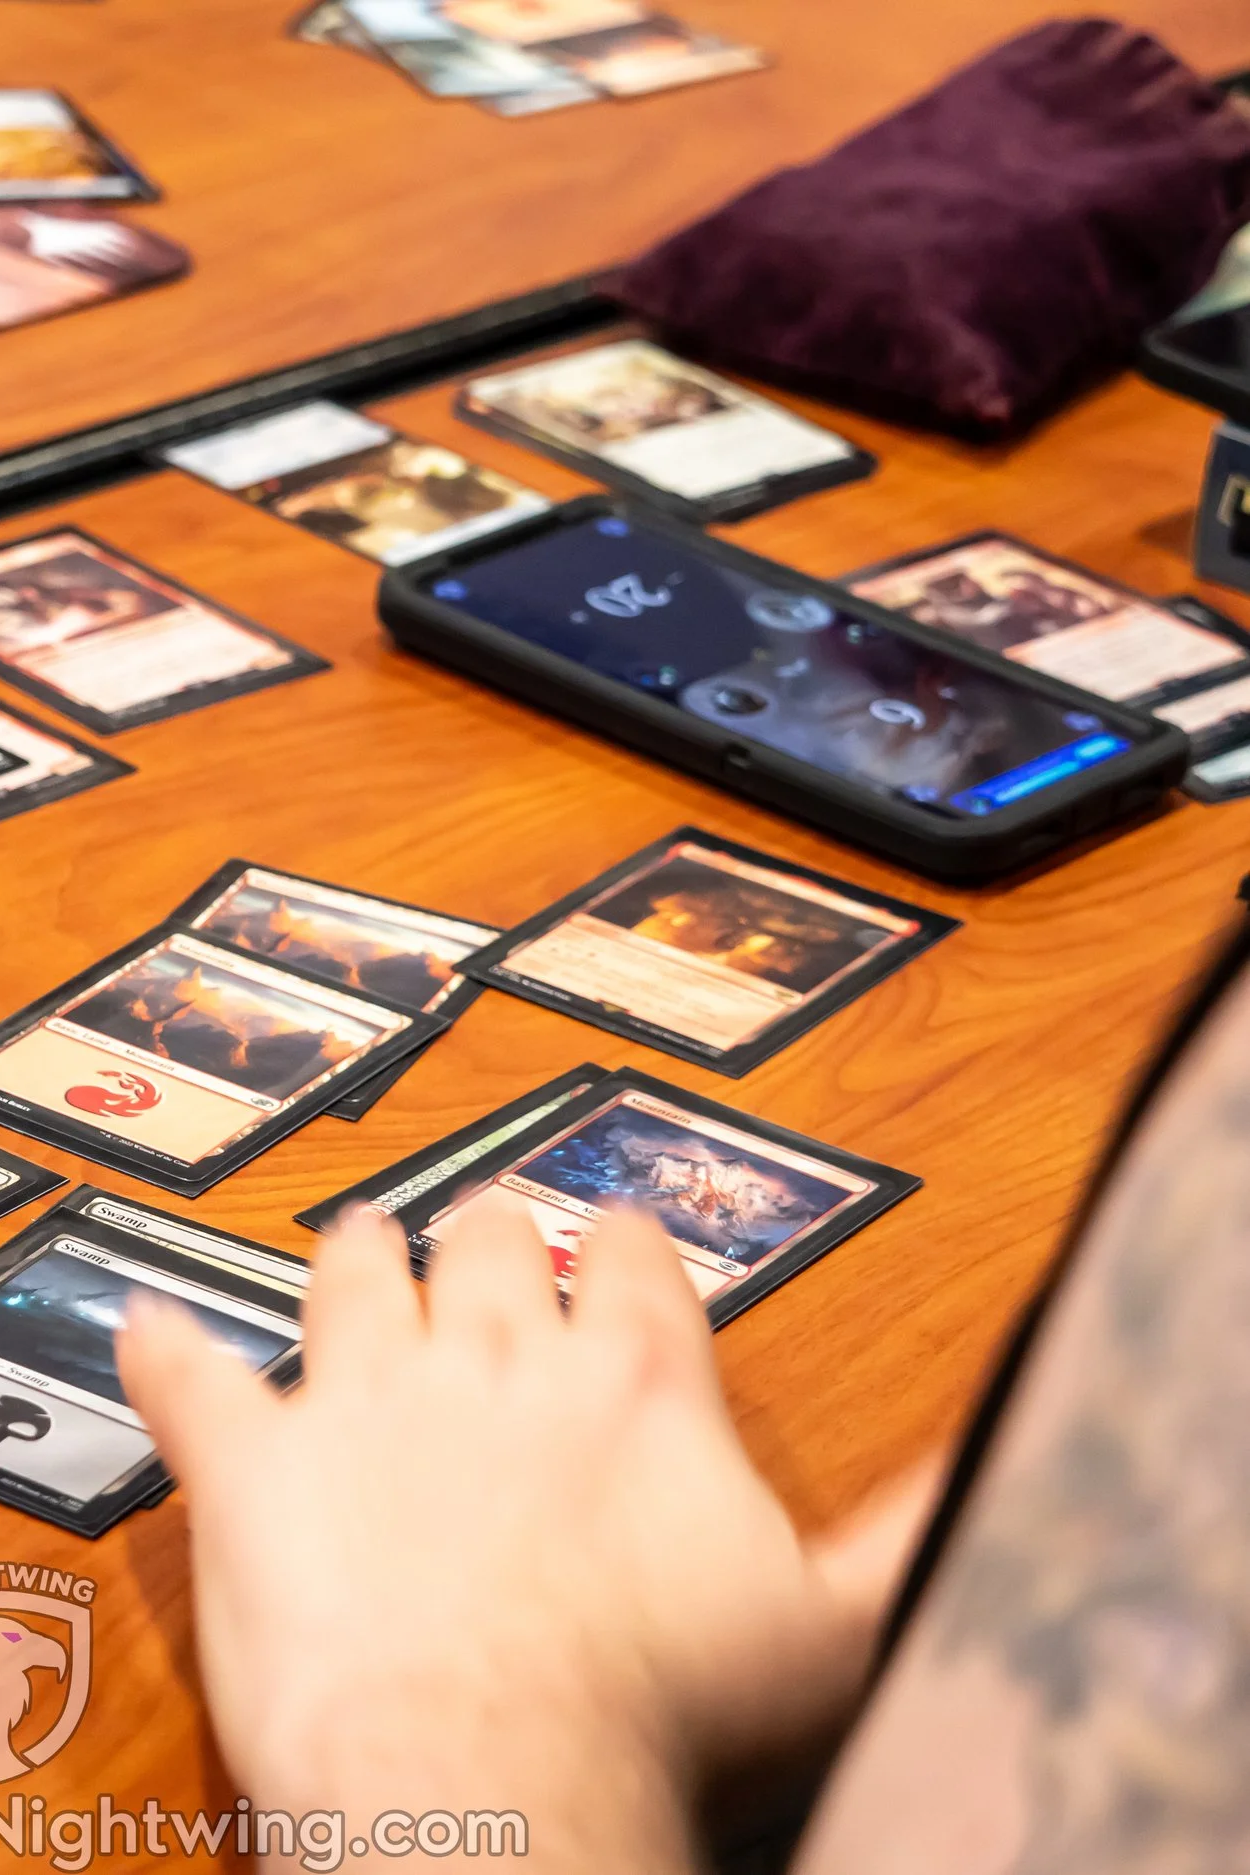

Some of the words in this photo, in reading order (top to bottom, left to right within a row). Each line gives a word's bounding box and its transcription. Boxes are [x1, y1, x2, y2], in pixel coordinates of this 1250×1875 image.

[632, 1098, 691, 1124] Mountain
[506, 1177, 536, 1192] Basic
[537, 1189, 568, 1204] Land
[98, 1207, 148, 1228] Swamp
[61, 1243, 111, 1265] Swamp
[8, 1366, 50, 1387] Swamp
